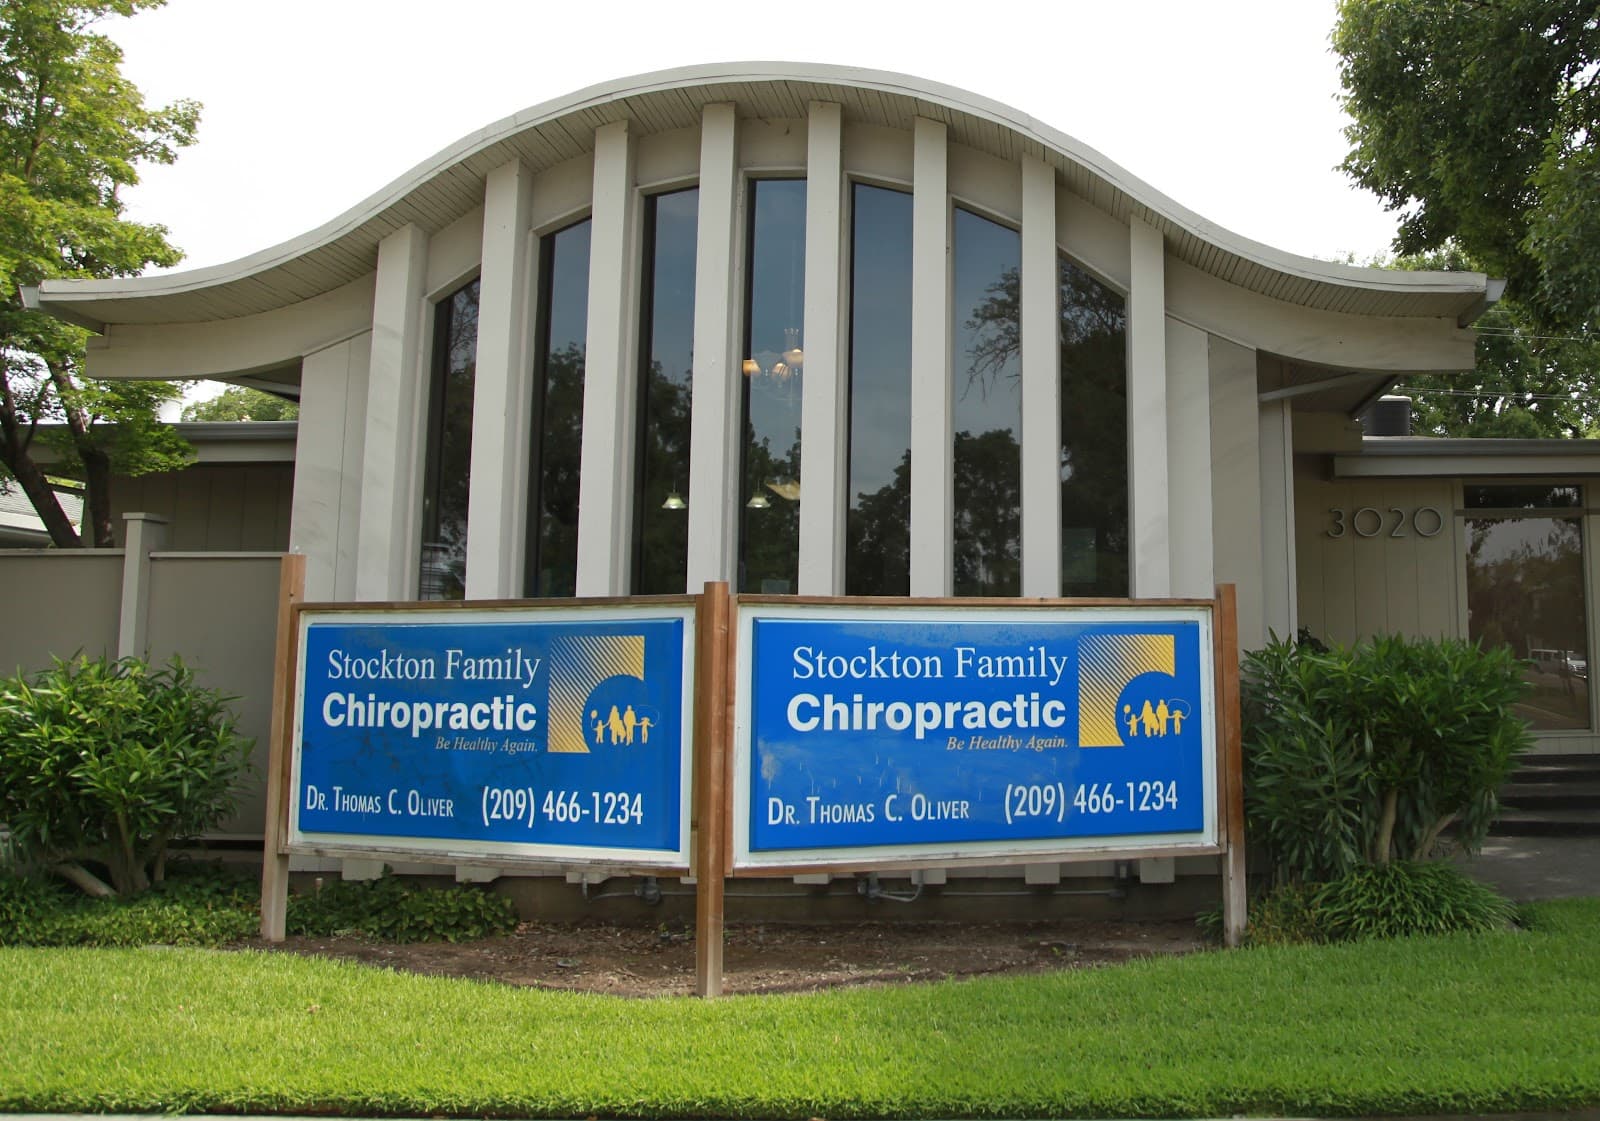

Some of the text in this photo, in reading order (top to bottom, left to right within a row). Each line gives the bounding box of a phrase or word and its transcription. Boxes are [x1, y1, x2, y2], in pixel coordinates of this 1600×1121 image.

[1327, 507, 1443, 538] 3020
[327, 648, 541, 688] Stockton Family
[792, 646, 1068, 685] Stockton Family
[322, 692, 537, 737] Chiropractic
[786, 692, 1066, 740] Chiropractic
[435, 737, 538, 755] Be Healthy Again.
[946, 736, 1068, 752] Be Healthy Again.
[388, 789, 402, 815] C.
[482, 786, 643, 828] (209) 466-1234
[885, 795, 903, 822] C.
[1004, 781, 1178, 824] (209) 466-1234
